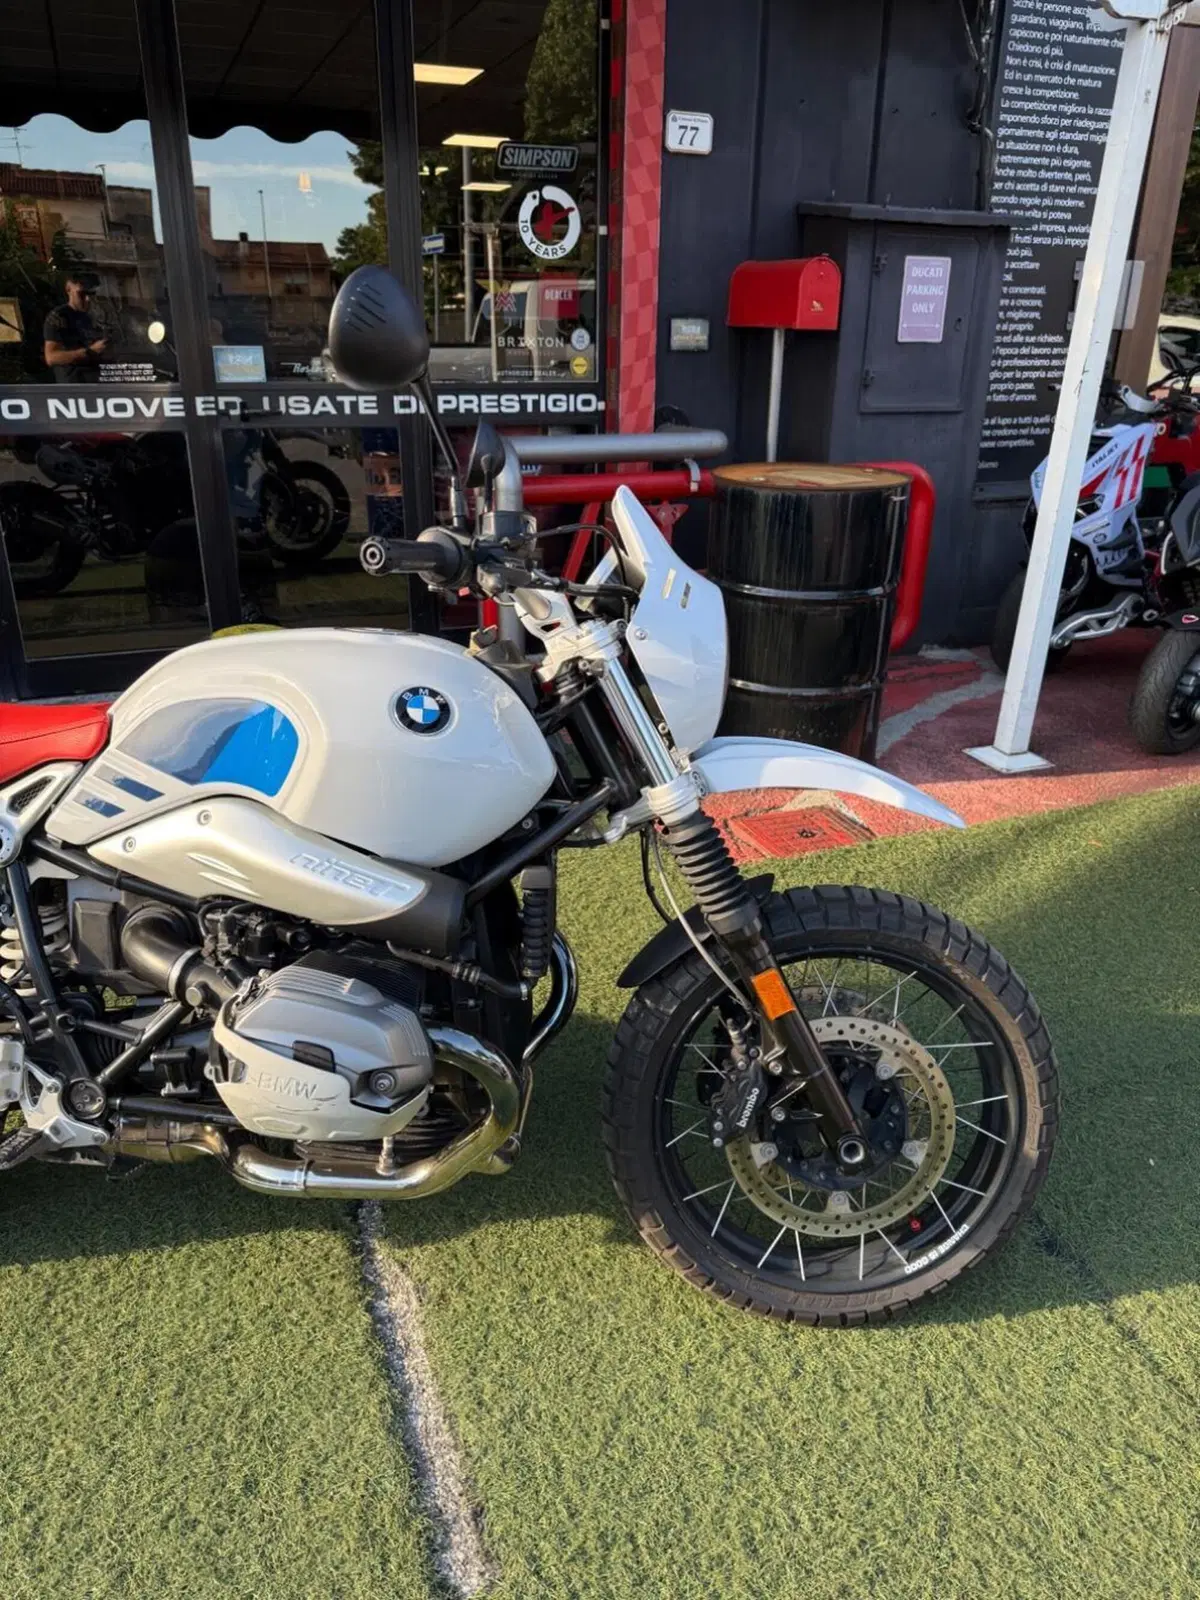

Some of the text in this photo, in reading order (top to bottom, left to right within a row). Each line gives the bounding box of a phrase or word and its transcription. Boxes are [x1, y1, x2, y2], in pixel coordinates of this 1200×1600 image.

[1043, 3, 1071, 14] persone
[1011, 13, 1047, 26] guardano,
[1049, 17, 1083, 30] viaggiano,
[1009, 28, 1043, 39] capiscono
[1051, 33, 1062, 42] poi
[1063, 35, 1109, 46] naturalmente
[1008, 41, 1042, 54] Chiedono
[1043, 44, 1050, 54] di
[1005, 55, 1021, 65] Non
[1050, 60, 1063, 71] crisi
[1064, 61, 1071, 71] di
[1072, 64, 1116, 75] maturazione.
[1004, 69, 1102, 88] Ed in un mercato che matura
[1002, 85, 1080, 99] cresce la competizione.
[1001, 98, 1010, 108] La
[1011, 100, 1058, 111] competizione
[1058, 102, 1086, 115] migliora
[1088, 105, 1094, 114] la
[1000, 111, 1040, 124] imponendo
[1041, 115, 1059, 125] sforzi
[1060, 118, 1072, 127] per
[678, 125, 699, 147] 77
[997, 125, 1045, 137] giornalmente
[1045, 129, 1058, 140] agli
[1059, 131, 1089, 140] standard
[996, 140, 1004, 148] La
[1006, 140, 1042, 151] situazione
[1042, 144, 1056, 152] non
[503, 147, 574, 168] SIMPSON
[1000, 155, 1050, 165] estremamente
[1051, 157, 1061, 167] più
[1016, 168, 1037, 178] molto
[1004, 181, 1015, 190] chi
[1016, 183, 1040, 192] accetta
[1041, 182, 1048, 192] di
[1049, 184, 1065, 193] stare
[1066, 184, 1077, 193] nel
[1020, 196, 1041, 207] regole
[1041, 197, 1054, 207] più
[1048, 212, 1071, 220] poteva
[1015, 234, 1032, 243] frutti
[1052, 236, 1063, 246] più
[528, 237, 567, 258] YEARS
[911, 266, 943, 278] DUCATI
[906, 284, 945, 296] PARKING
[912, 302, 935, 313] ONLY
[497, 336, 565, 348] BRIXTON
[1022, 370, 1045, 380] propria
[990, 381, 1014, 392] proprio
[47, 397, 186, 419] NUOVE
[262, 395, 379, 416] USATE
[402, 688, 446, 704] BMW
[257, 1071, 318, 1099] BMW
[735, 1087, 760, 1128] brembo
